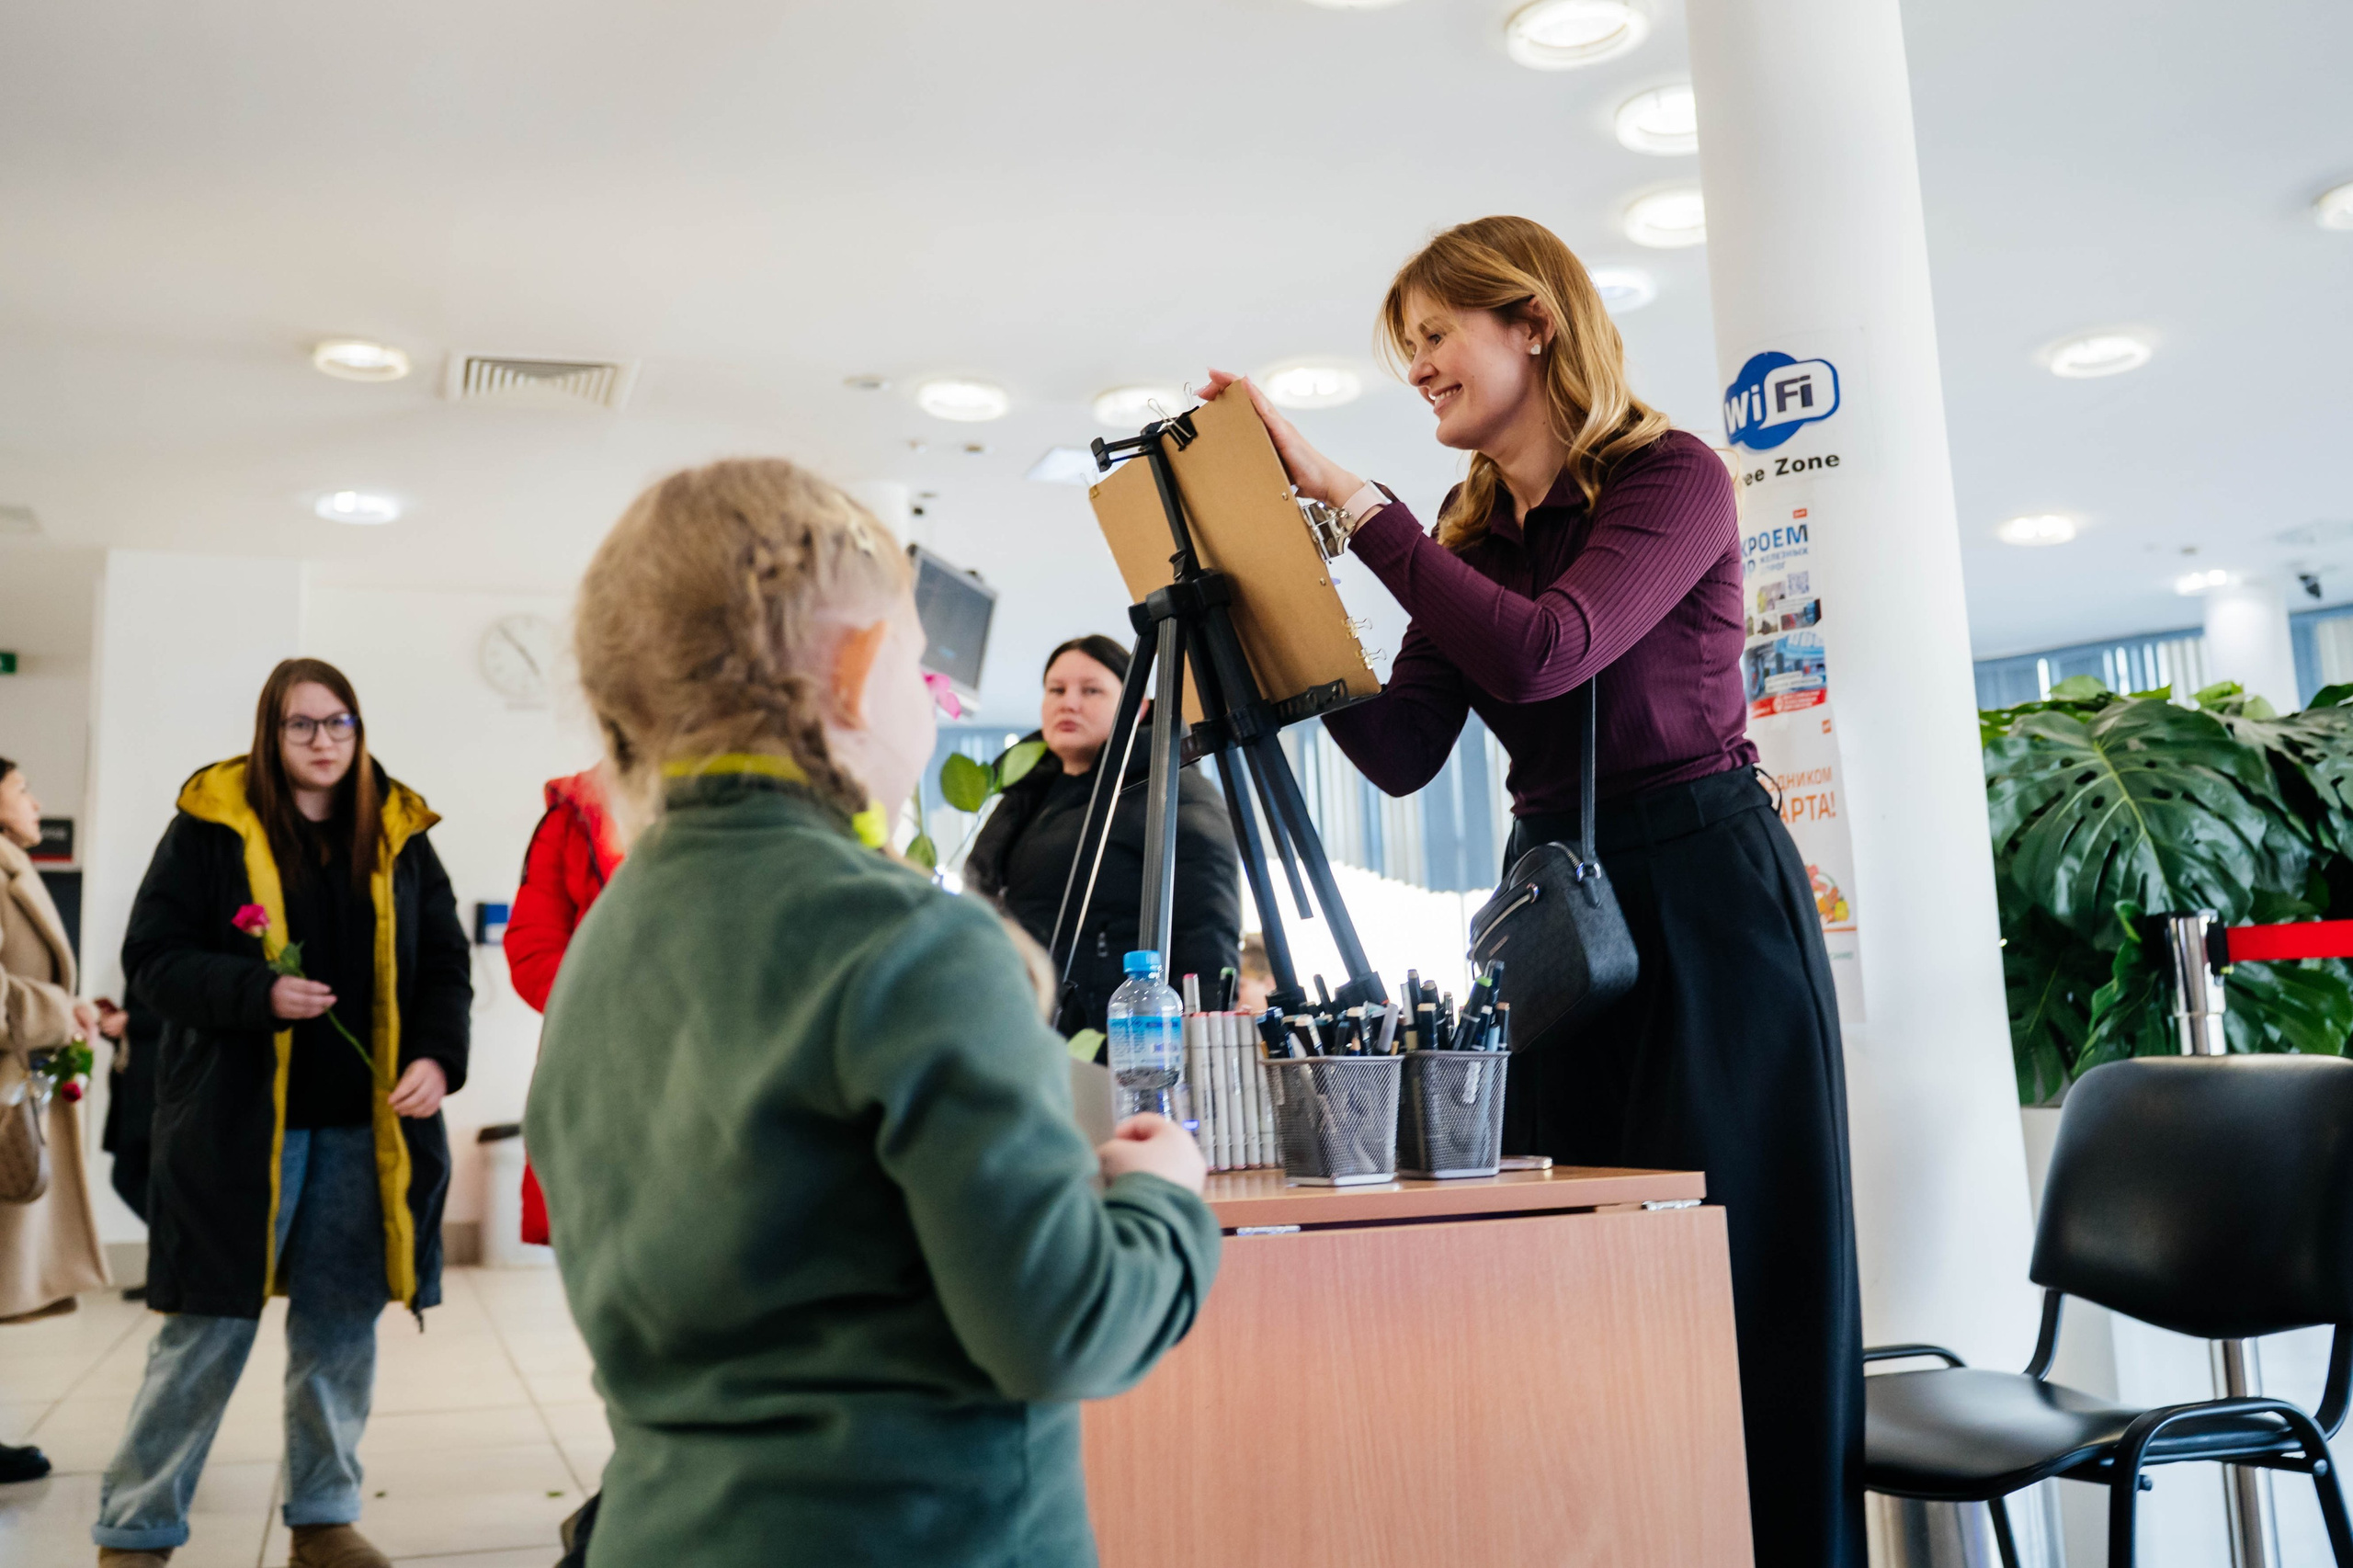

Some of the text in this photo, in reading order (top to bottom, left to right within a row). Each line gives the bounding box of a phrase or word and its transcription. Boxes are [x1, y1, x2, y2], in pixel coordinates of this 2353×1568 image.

[1744, 454, 1840, 486] ee Zone
[1780, 790, 1836, 824] АРТА!
